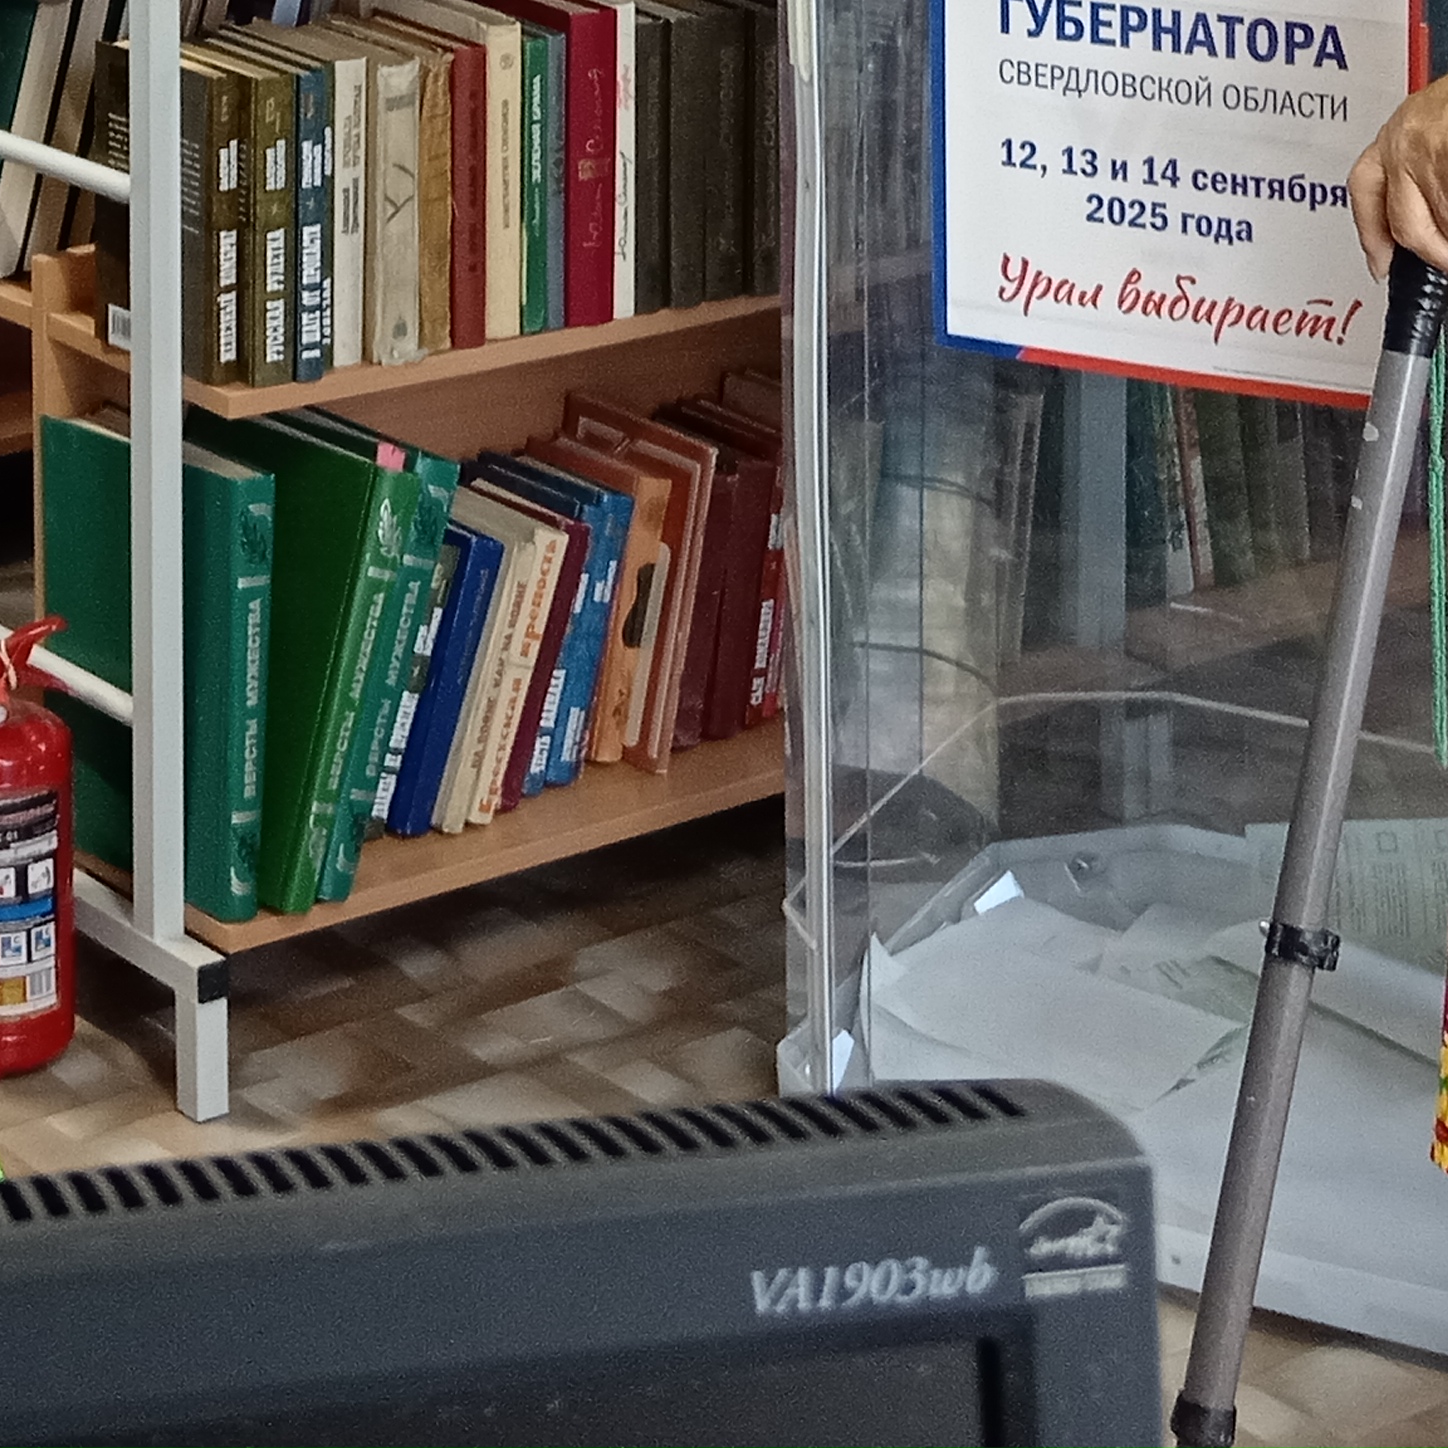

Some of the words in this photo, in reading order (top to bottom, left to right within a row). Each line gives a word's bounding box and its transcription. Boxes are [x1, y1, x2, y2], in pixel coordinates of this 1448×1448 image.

[532, 74, 542, 121] БРАМА
[998, 58, 1212, 110] СВЕРДЛОВСКОЙ
[1222, 83, 1349, 122] ОБЛАСТИ
[532, 122, 542, 184] ЗЕЛЕНАЯ
[999, 138, 1048, 177] 12,
[1061, 145, 1100, 179] 13
[1110, 157, 1129, 183] и
[1141, 154, 1181, 189] 14
[1191, 169, 1349, 209] сентября
[1085, 192, 1170, 234] 2025
[1180, 208, 1255, 246] года
[266, 228, 285, 292] РУЛЕТКА
[266, 299, 285, 363] РУССКАЯ
[998, 252, 1104, 312] Урал
[1116, 266, 1364, 347] выбирает!
[385, 580, 421, 686] МУЖЕСТВА
[518, 538, 556, 658] крепость
[245, 598, 262, 706] МУЖЕСТВА
[328, 711, 355, 790] ВЕРСТЫ
[348, 591, 385, 700] МУЖЕСТВА
[243, 718, 258, 799] ВЕРСТЫ
[750, 1245, 998, 1317] VA1903wb
